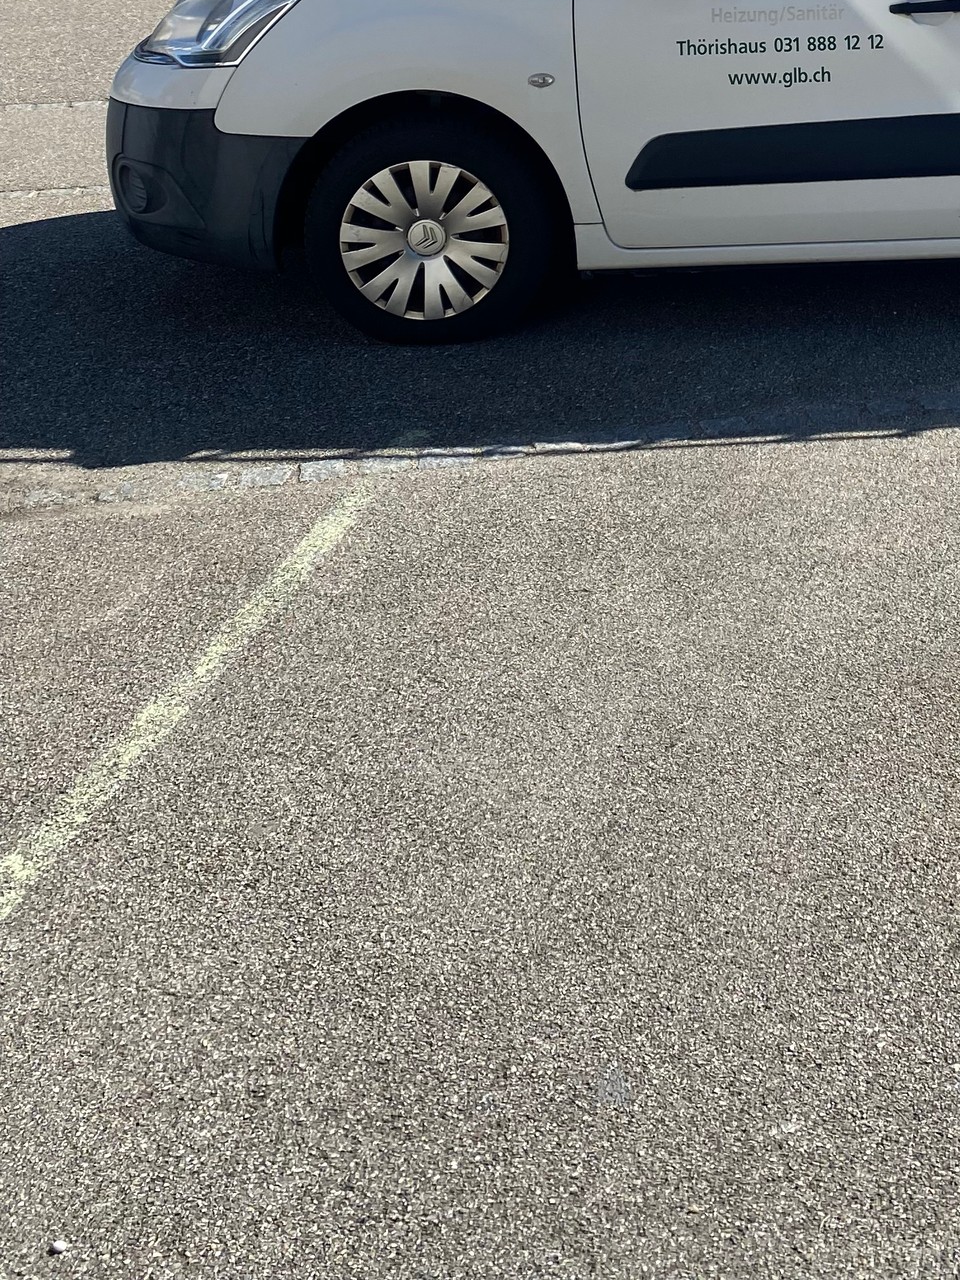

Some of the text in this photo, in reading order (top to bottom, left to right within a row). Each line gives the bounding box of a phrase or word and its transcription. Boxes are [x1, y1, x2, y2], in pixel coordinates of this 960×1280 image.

[710, 4, 845, 26] Heizung/Sanitär
[676, 34, 884, 56] Thörishaus 031 888 12 12
[728, 66, 832, 87] www.glb.ch
